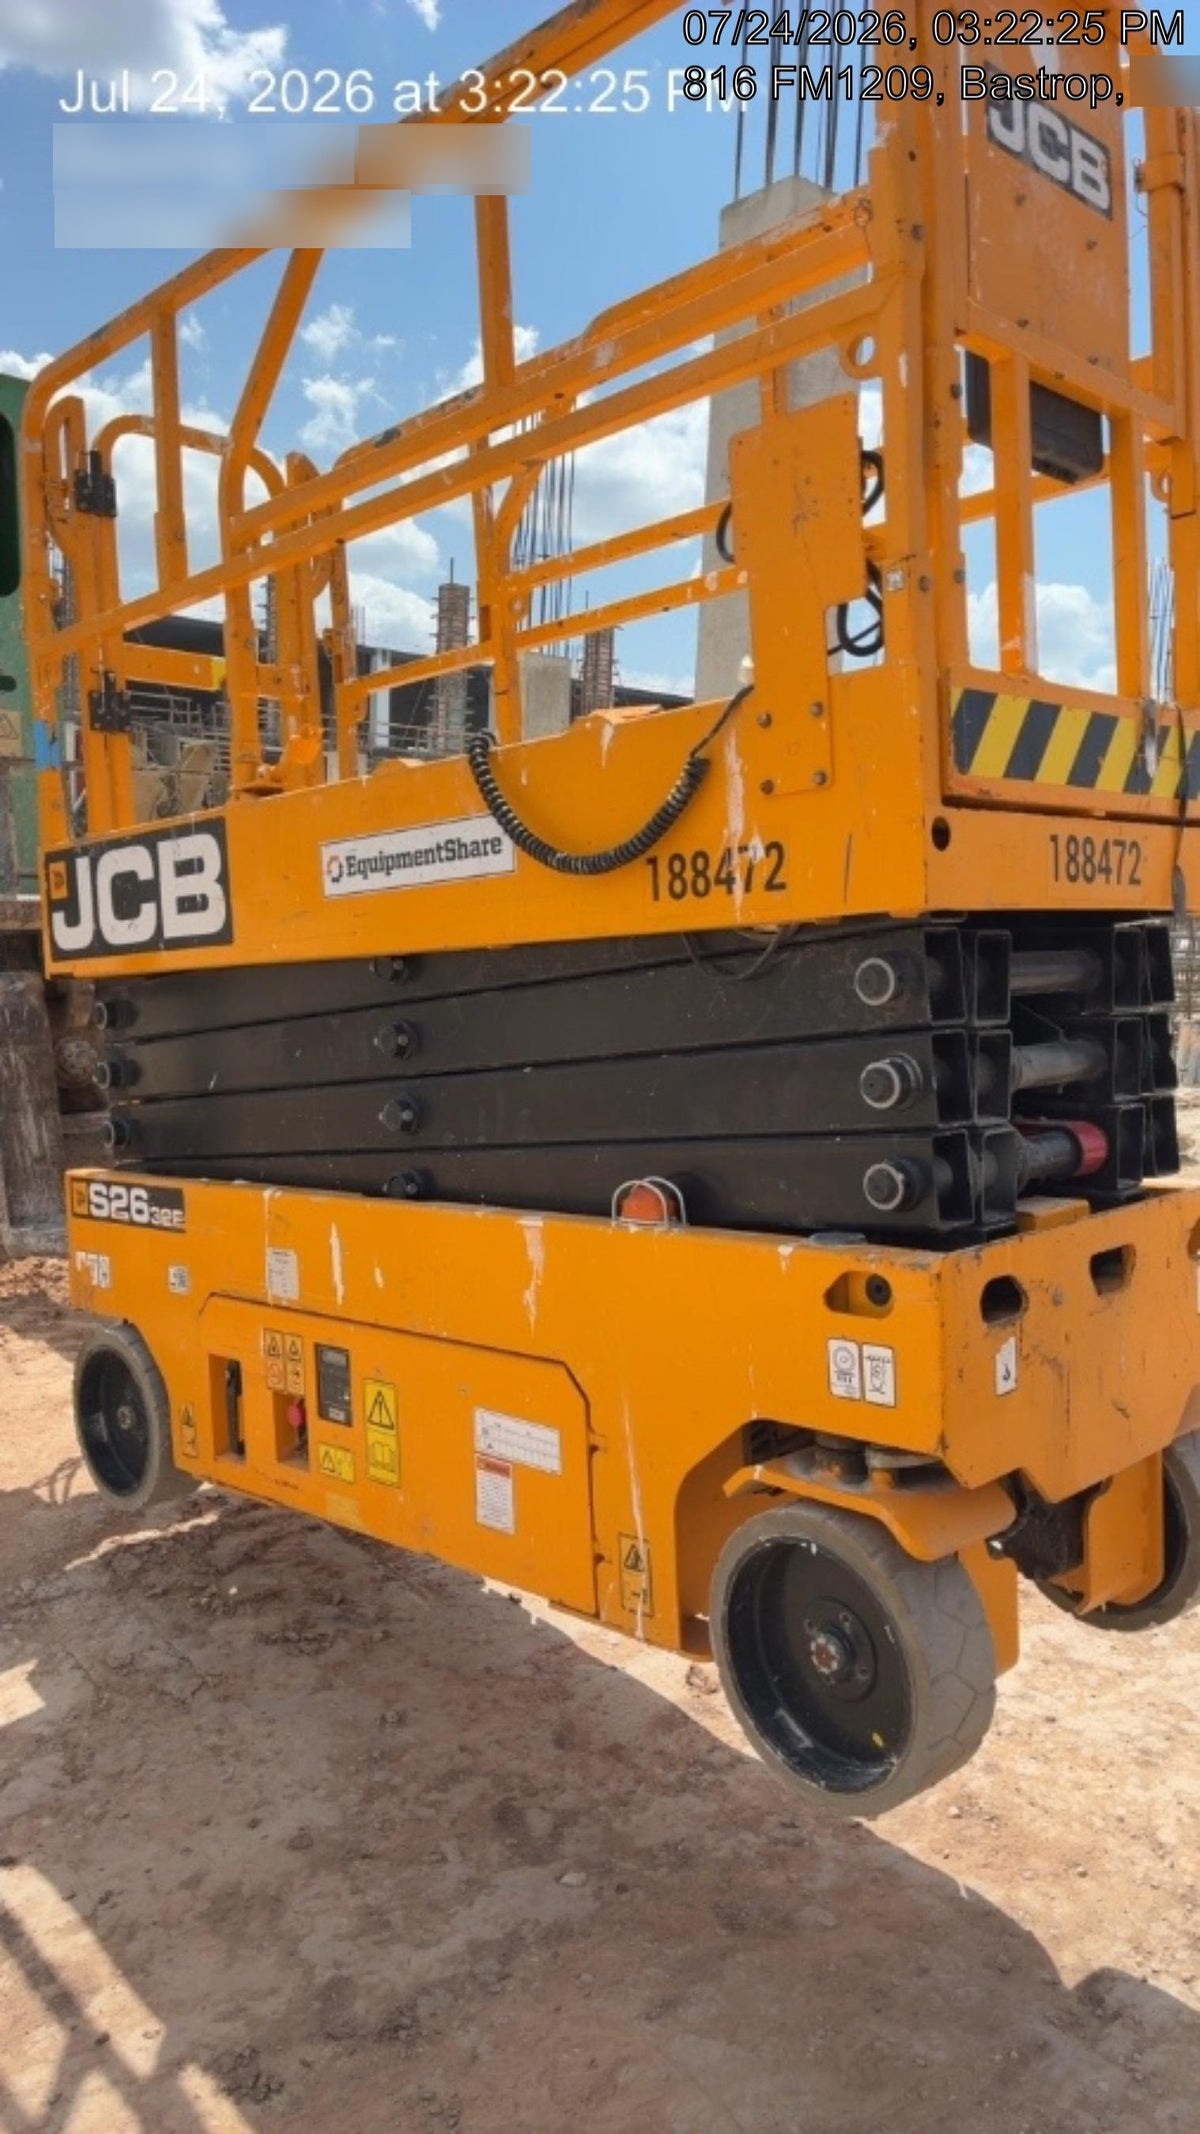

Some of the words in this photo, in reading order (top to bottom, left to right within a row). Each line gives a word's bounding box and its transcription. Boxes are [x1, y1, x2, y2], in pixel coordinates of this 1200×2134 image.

[987, 92, 1111, 211] JCB
[346, 835, 503, 880] EquipmentShare
[646, 841, 787, 902] 188472
[1050, 834, 1142, 885] 188472
[52, 833, 226, 951] JCB
